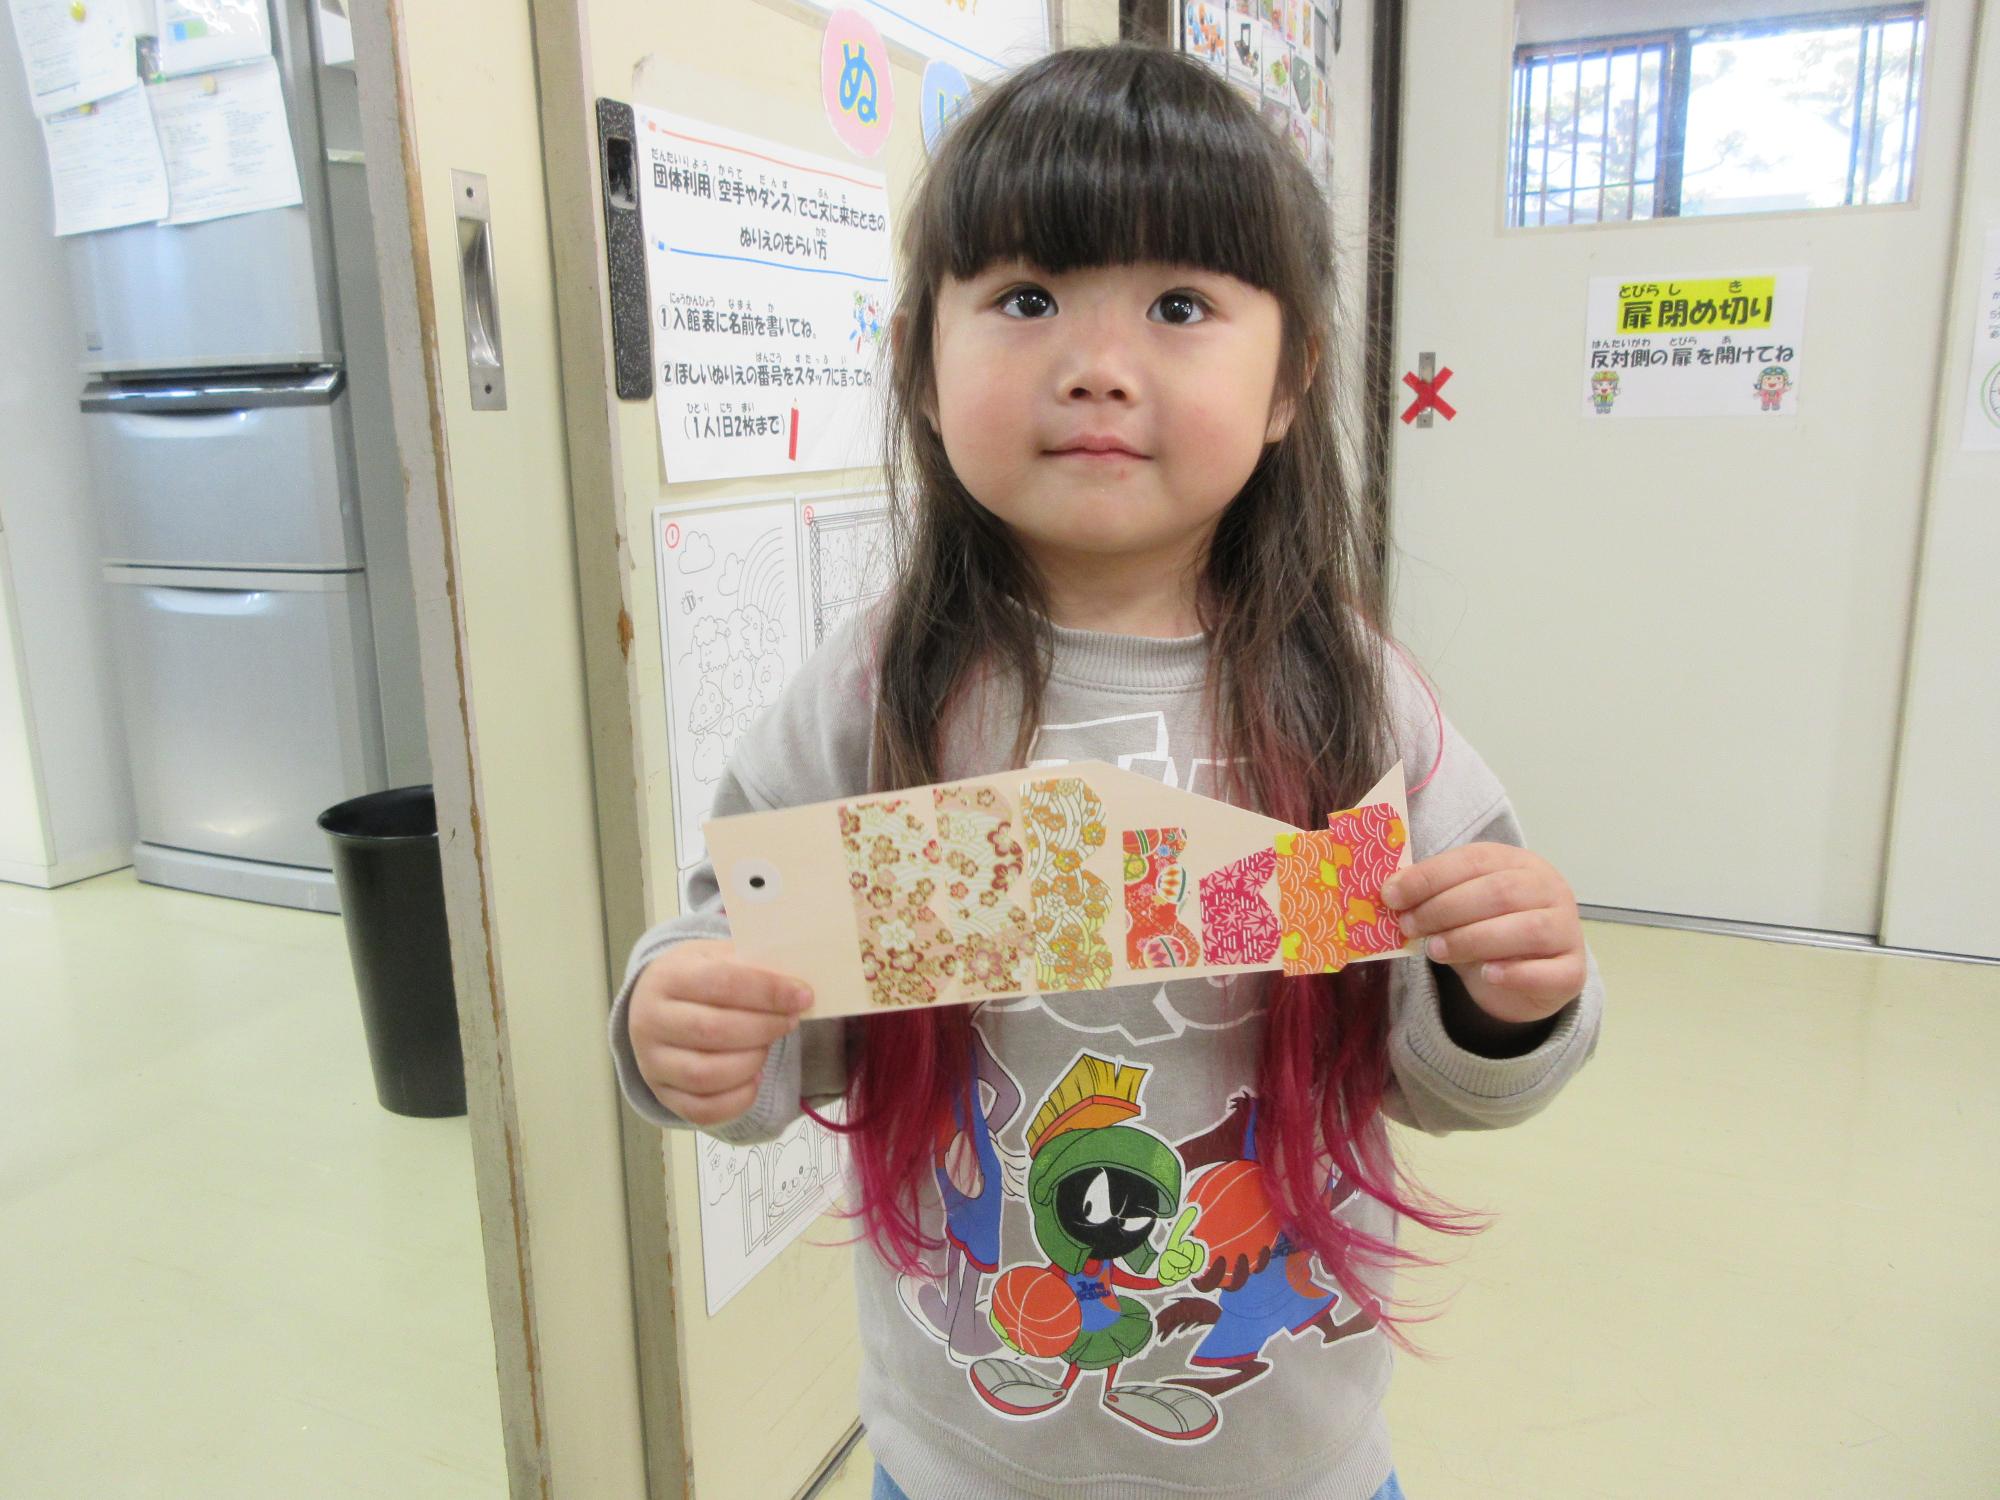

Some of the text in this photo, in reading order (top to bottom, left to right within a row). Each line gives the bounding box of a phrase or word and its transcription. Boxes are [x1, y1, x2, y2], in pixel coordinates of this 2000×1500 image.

[838, 40, 879, 128] ぬ
[740, 226, 828, 260] ぬりえのもらい方
[1619, 280, 1743, 299] とびら し き
[1622, 296, 1773, 328] 扉閉め切り
[1669, 336, 1698, 347] とびら
[1721, 335, 1732, 345] あ
[1590, 344, 1795, 369] 反対側の扉を開けてね
